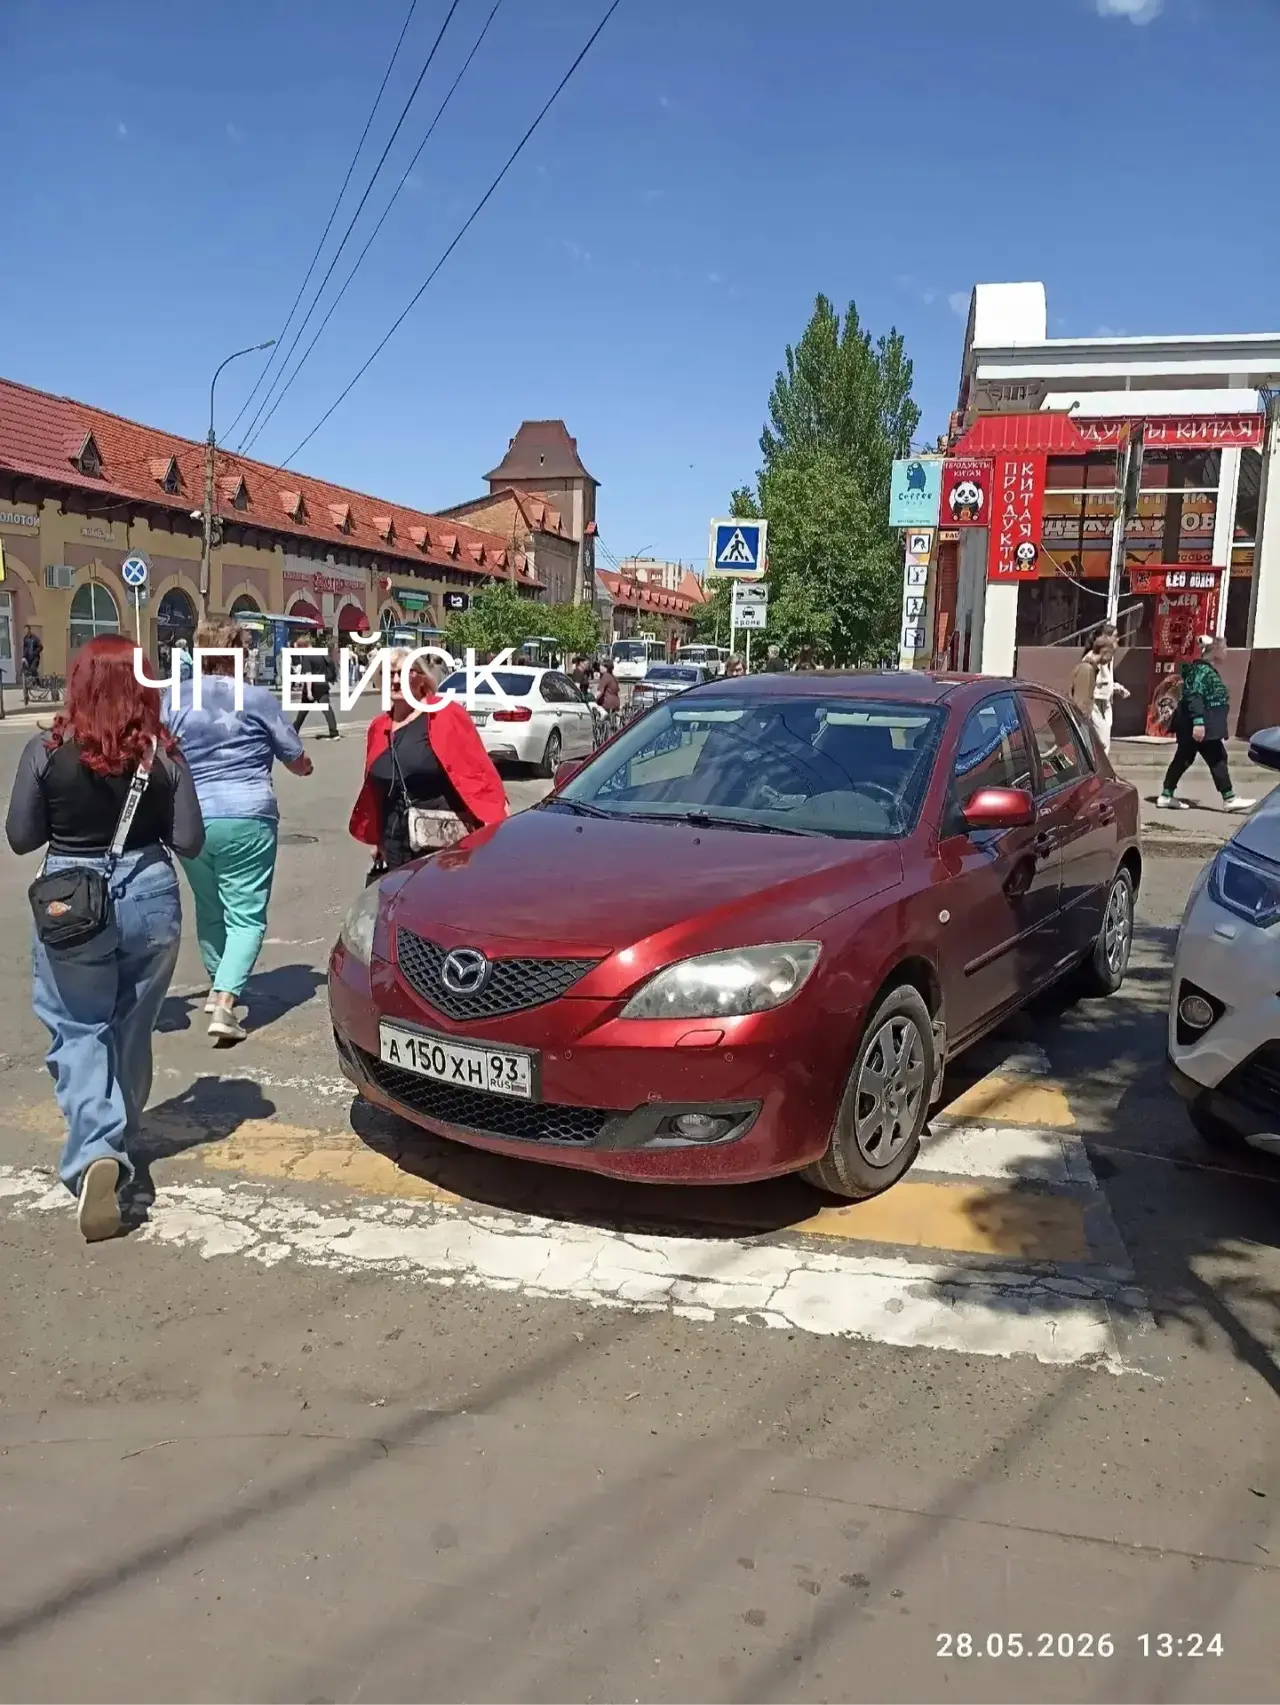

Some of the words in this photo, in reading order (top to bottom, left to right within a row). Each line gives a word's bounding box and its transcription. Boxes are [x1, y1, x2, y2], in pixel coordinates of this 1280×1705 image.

[1176, 420, 1252, 439] КИТАЯ
[1019, 462, 1034, 537] КИТАЯ
[999, 462, 1018, 573] ПРОДУКТЫ
[490, 1056, 518, 1081] 93
[490, 1079, 511, 1090] RUS
